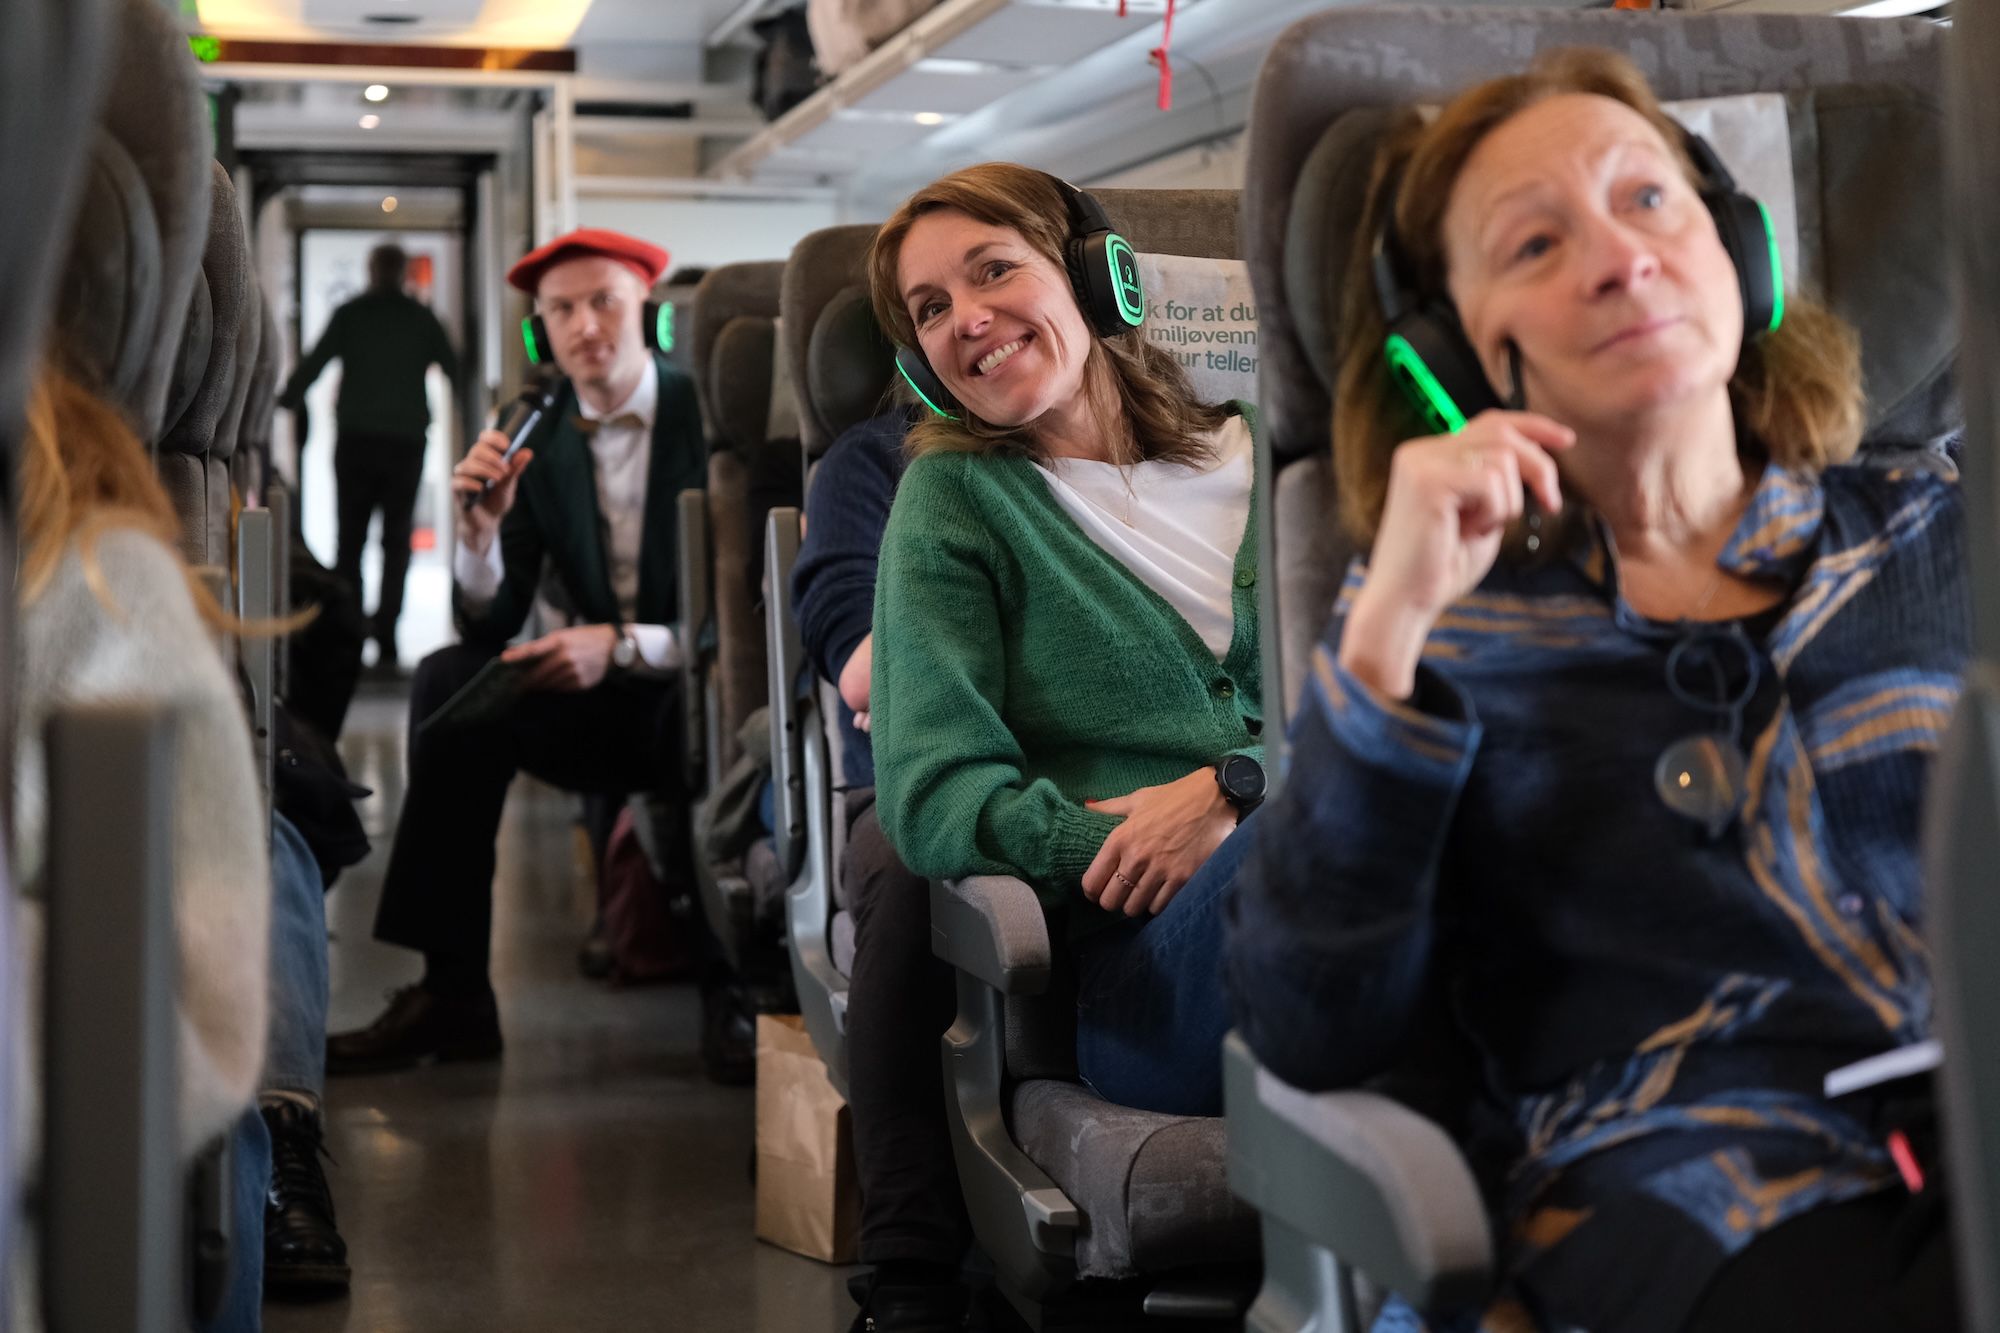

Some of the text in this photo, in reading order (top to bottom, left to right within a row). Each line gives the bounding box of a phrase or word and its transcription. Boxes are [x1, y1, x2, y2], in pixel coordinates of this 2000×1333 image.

[1165, 300, 1197, 321] for
[1202, 305, 1225, 322] at
[1230, 302, 1257, 322] du
[1205, 349, 1259, 373] teller
